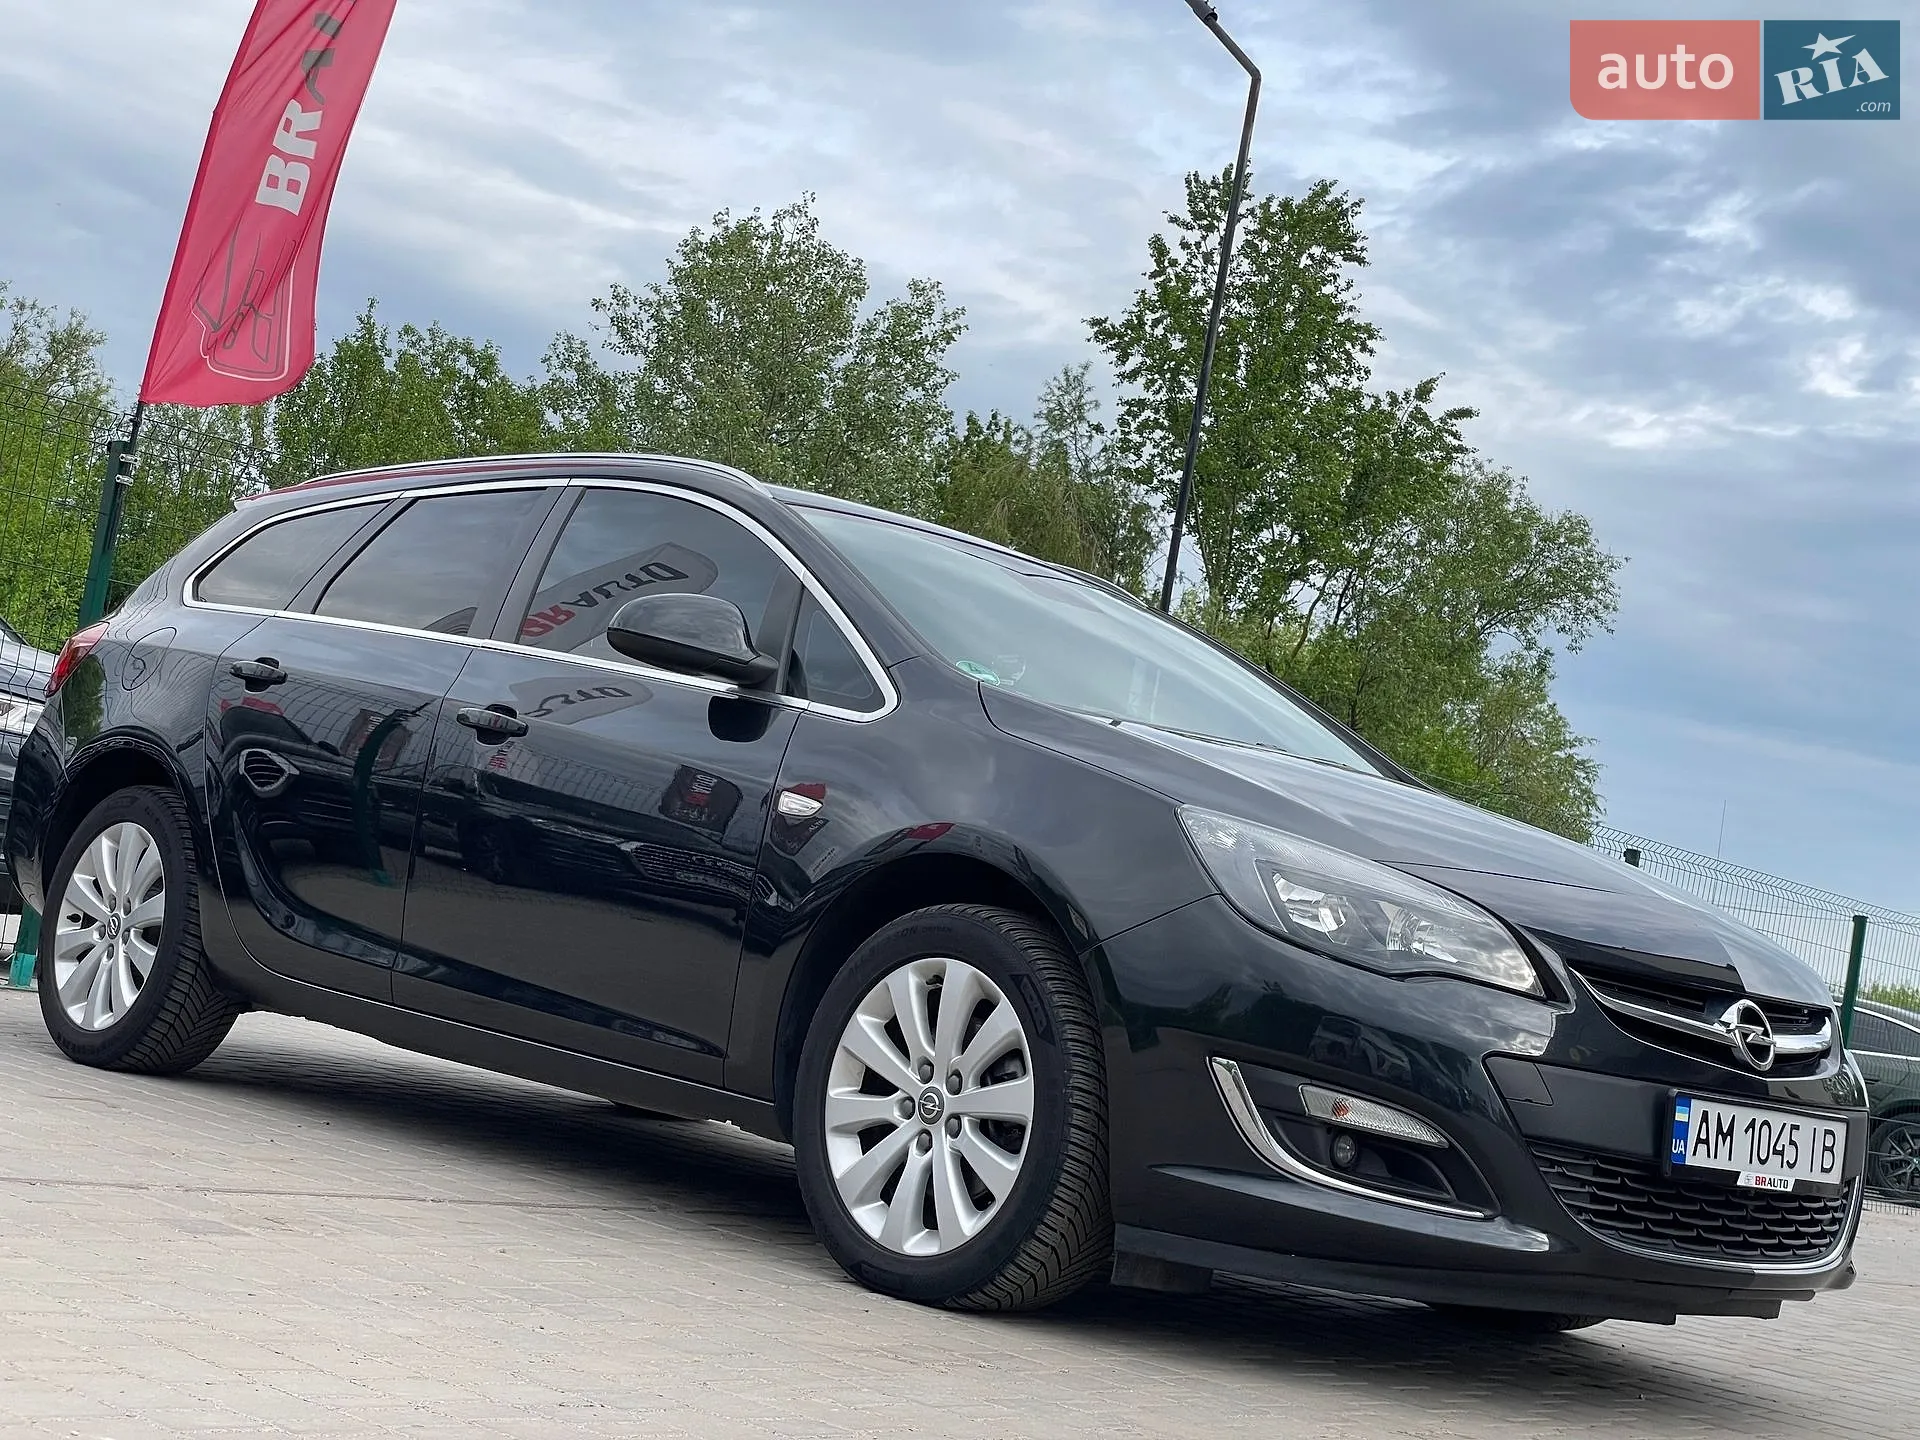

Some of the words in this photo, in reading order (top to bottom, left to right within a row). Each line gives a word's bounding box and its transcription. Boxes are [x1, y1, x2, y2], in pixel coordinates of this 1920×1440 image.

[1672, 1138, 1685, 1155] UA
[1692, 1109, 1736, 1161] AM
[1744, 1117, 1800, 1169] 1045
[1810, 1127, 1836, 1174] IB
[1754, 1175, 1789, 1190] BRAUTO
